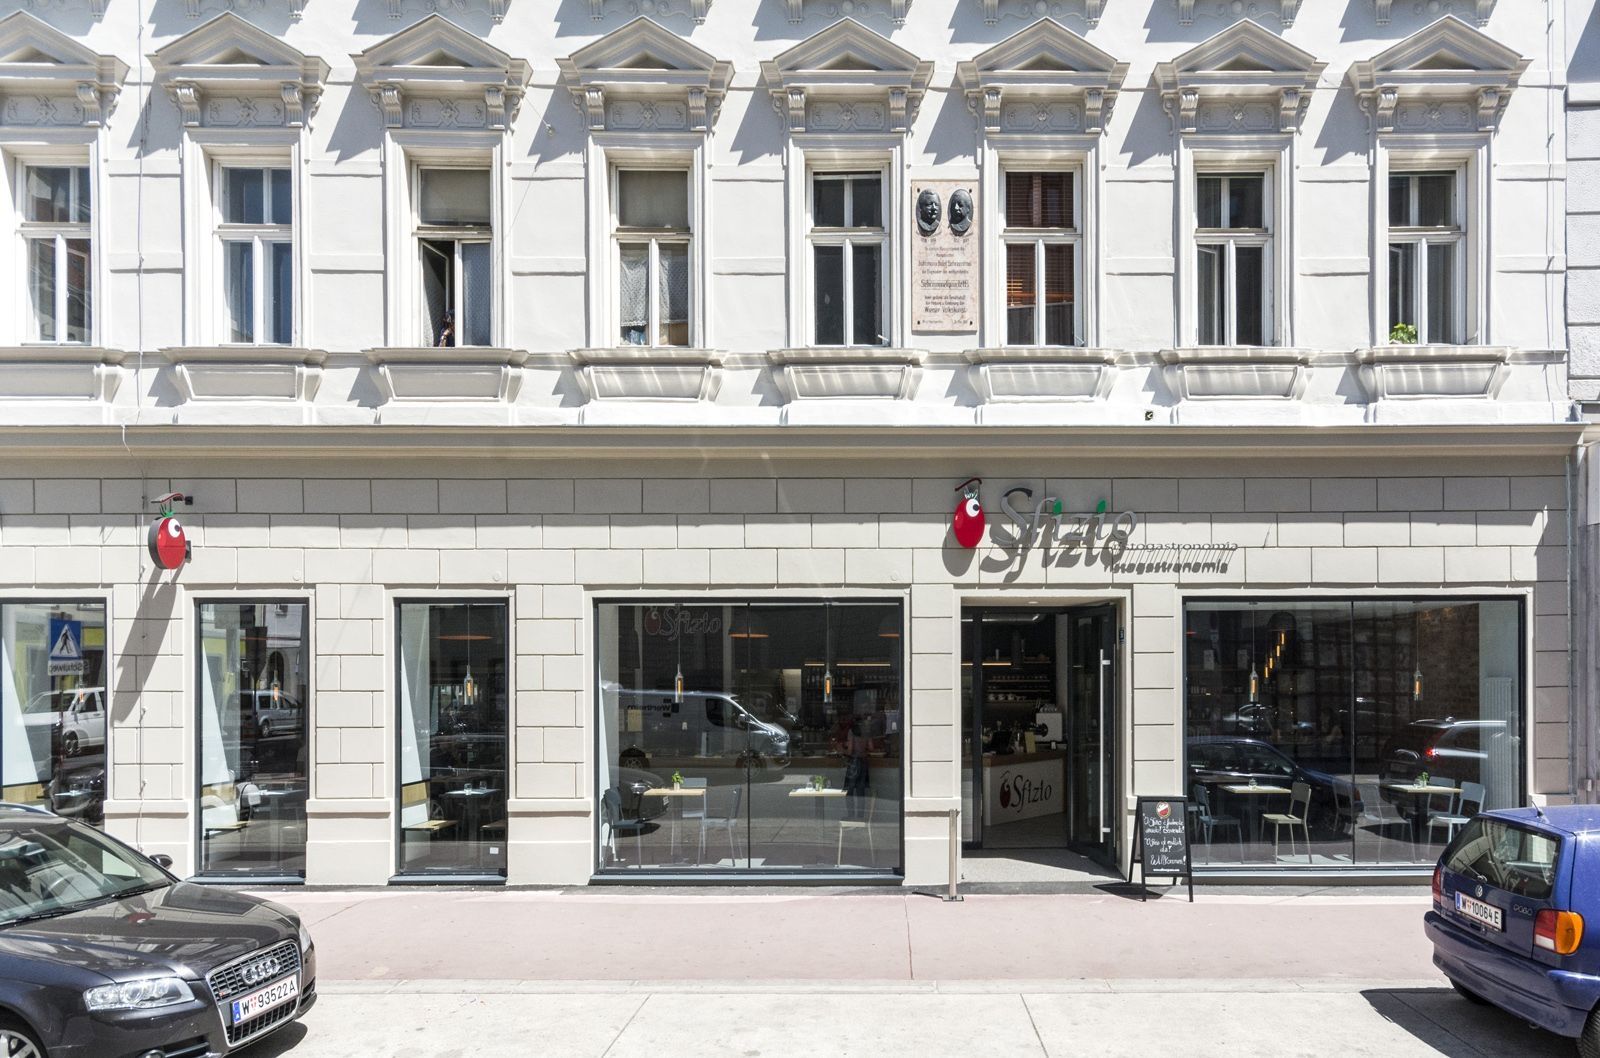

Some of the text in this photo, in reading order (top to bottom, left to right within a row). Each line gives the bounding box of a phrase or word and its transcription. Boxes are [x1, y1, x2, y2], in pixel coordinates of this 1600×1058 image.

[994, 487, 1137, 549] Sfizio
[1010, 774, 1052, 814] Sfizio
[242, 999, 250, 1016] W
